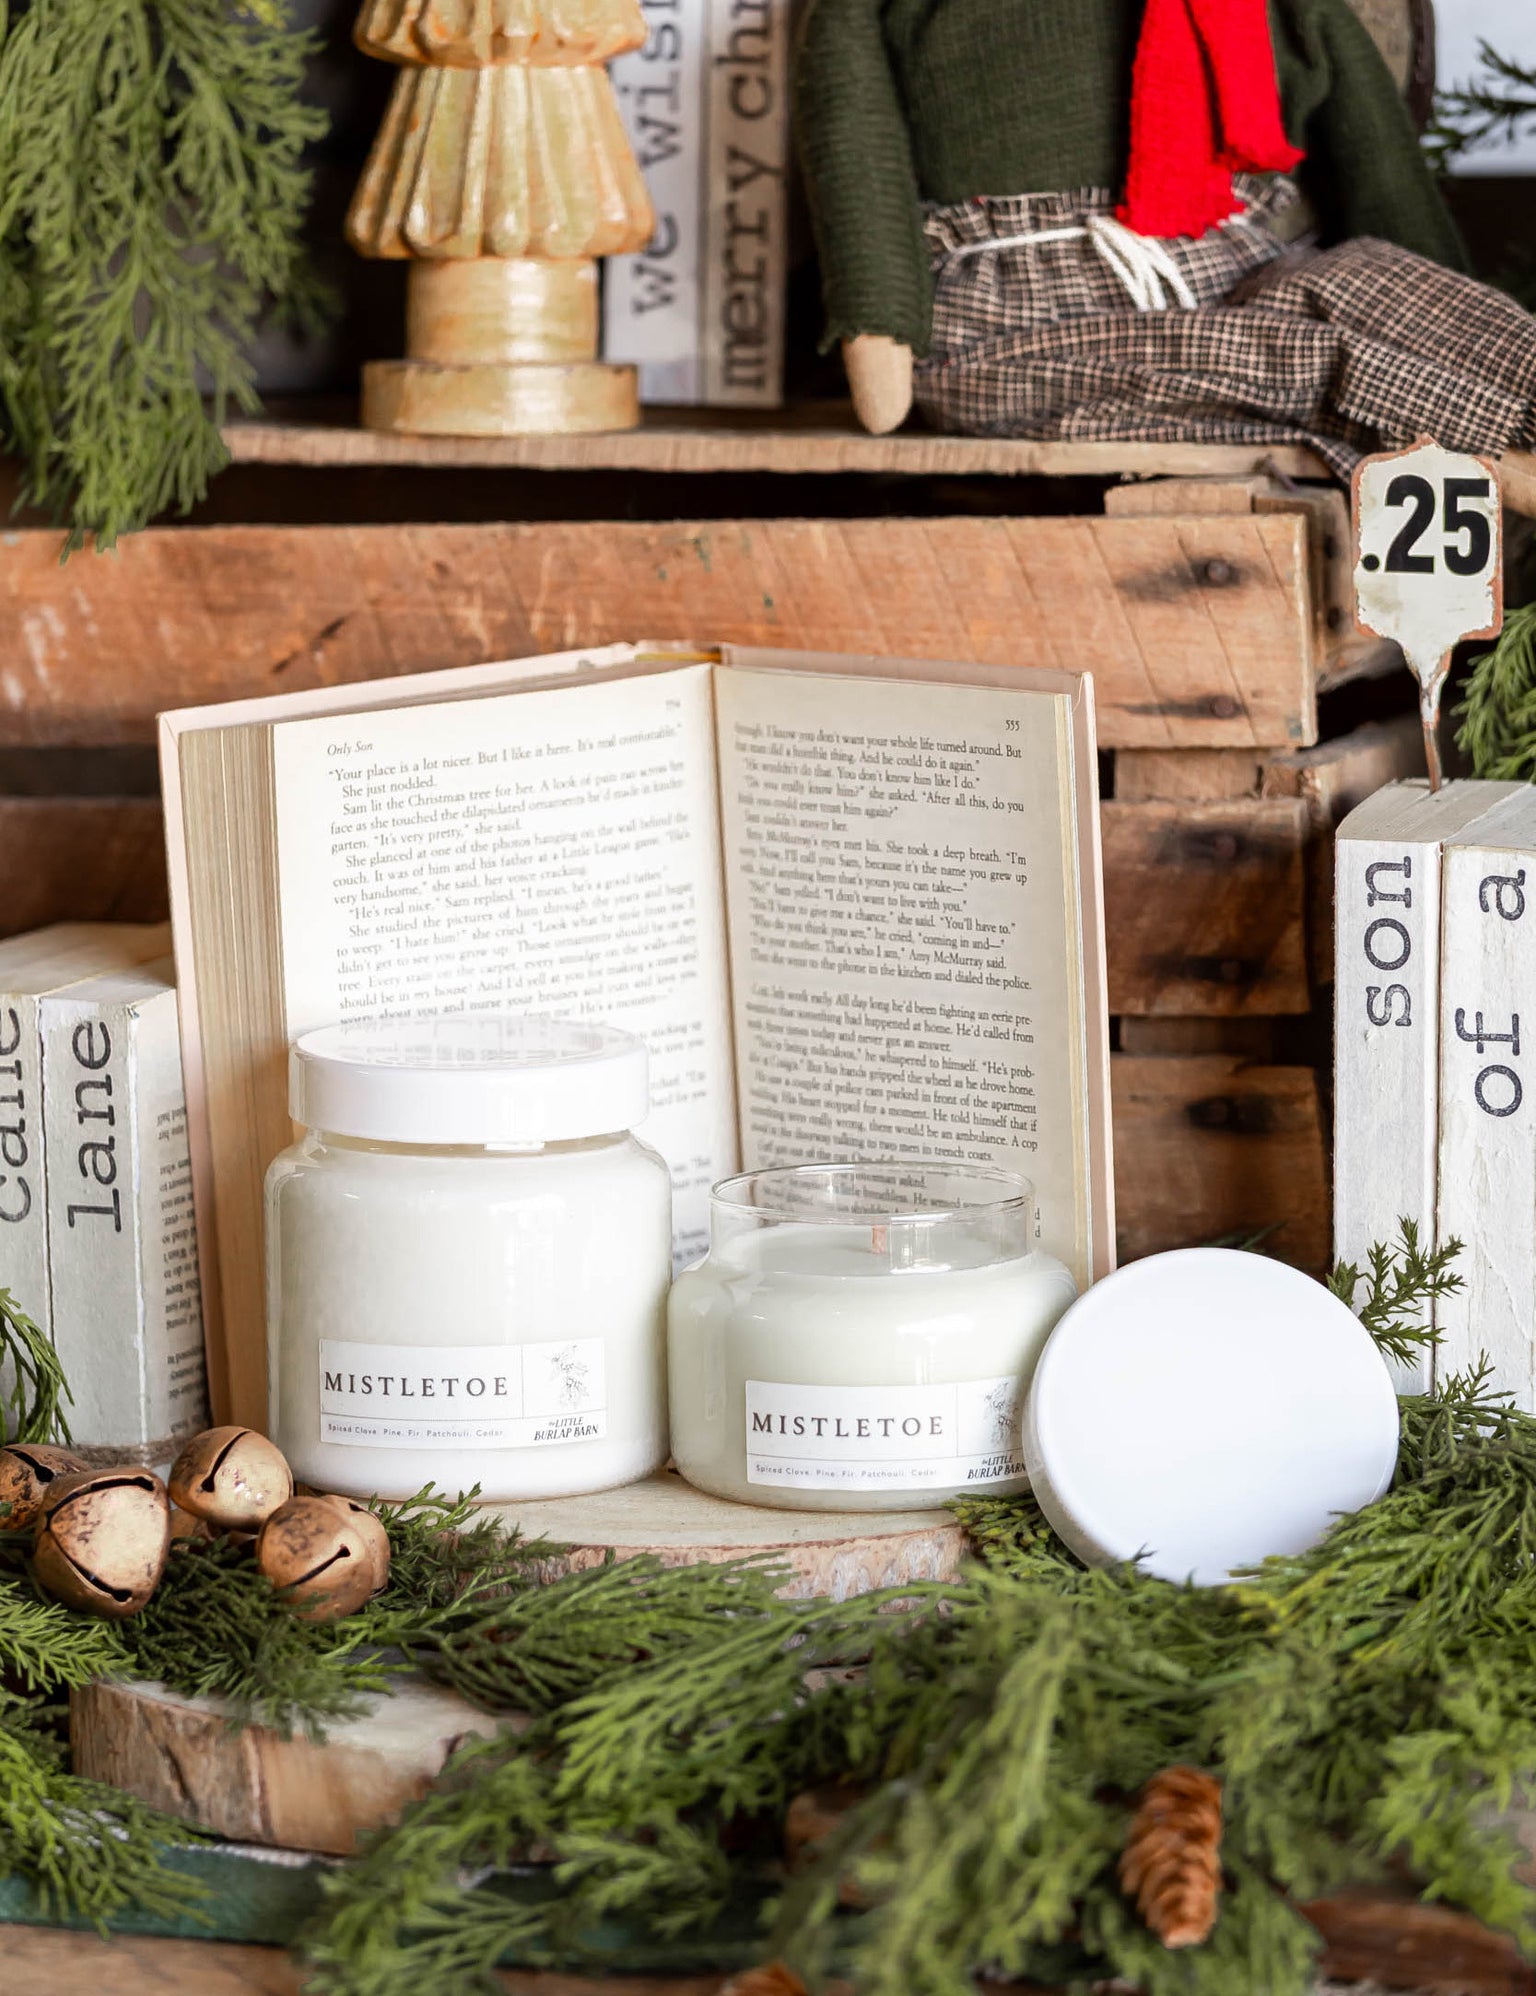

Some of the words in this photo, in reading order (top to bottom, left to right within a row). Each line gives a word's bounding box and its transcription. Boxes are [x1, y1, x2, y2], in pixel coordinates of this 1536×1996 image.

[621, 0, 682, 170] wis
[721, 145, 787, 391] merry
[1361, 474, 1490, 576] .25
[1006, 720, 1019, 731] 555
[327, 742, 351, 756] Only
[354, 741, 373, 752] Son
[920, 738, 934, 750] life
[936, 741, 967, 753] turned
[969, 744, 1003, 756] around.
[1006, 745, 1021, 758] But
[329, 769, 362, 781] "Your
[367, 765, 396, 780] place
[423, 759, 437, 770] lot
[478, 752, 497, 765] But
[897, 754, 922, 767] could
[925, 756, 937, 768] do
[949, 760, 979, 774] again."
[342, 785, 363, 798] She
[367, 784, 386, 797] just
[390, 775, 437, 792] nodded.
[934, 773, 951, 787] like
[343, 803, 367, 815] Sam
[371, 800, 382, 812] lit
[387, 798, 404, 810] the
[408, 794, 465, 807] Christmas
[469, 791, 491, 800] tree
[922, 791, 950, 804] "After
[955, 793, 966, 806] all
[969, 795, 989, 810] this,
[992, 797, 1005, 809] do
[1008, 802, 1024, 813] you
[331, 823, 352, 835] face
[370, 818, 389, 829] she
[392, 810, 438, 827] touched
[441, 809, 459, 821] the
[462, 800, 525, 820] dilapidated
[332, 841, 369, 855] garten.
[374, 833, 397, 846] "It's
[401, 834, 424, 844] very
[346, 855, 366, 868] She
[370, 848, 412, 868] glanced
[430, 848, 451, 857] one
[492, 837, 531, 853] photos
[908, 844, 929, 856] took
[943, 846, 965, 862] deep
[970, 848, 1001, 862] breath.
[1006, 852, 1026, 865] "I'm
[333, 872, 369, 888] couch.
[375, 870, 383, 882] It
[388, 871, 409, 879] was
[428, 863, 450, 875] him
[455, 858, 476, 872] and
[480, 857, 497, 869] his
[922, 862, 937, 875] the
[941, 867, 966, 877] name
[969, 870, 986, 880] you
[990, 872, 1012, 882] grew
[1016, 875, 1027, 886] up
[334, 895, 357, 905] very
[432, 880, 451, 892] she
[919, 898, 940, 910] with
[1478, 868, 1526, 921] a
[349, 906, 379, 919] "He's
[384, 902, 404, 915] real
[445, 896, 469, 908] Sam
[349, 925, 370, 937] She
[376, 918, 417, 934] studied
[423, 916, 441, 928] the
[446, 914, 493, 928] pictures
[940, 916, 972, 930] "You'll
[976, 919, 996, 933] have
[999, 923, 1015, 934] to."
[918, 932, 958, 949] "coming
[1363, 855, 1412, 1027] son
[337, 960, 371, 974] didn't
[909, 949, 930, 965] Amy
[934, 951, 983, 970] McMurray
[986, 957, 1007, 969] said.
[934, 969, 952, 982] and
[955, 970, 983, 984] dialed
[986, 973, 1001, 986] the
[1003, 976, 1032, 990] police.
[340, 993, 377, 1009] should
[939, 1004, 975, 1022] fighting
[991, 1013, 1013, 1023] eerie
[1016, 1016, 1032, 1027] pre-
[924, 1020, 953, 1034] home.
[957, 1023, 980, 1037] He'd
[983, 1027, 1010, 1040] called
[1013, 1029, 1034, 1043] from
[917, 1041, 951, 1052] answer.
[942, 1056, 978, 1072] himself.
[982, 1061, 1008, 1075] "He's
[1011, 1066, 1035, 1079] prob-
[1455, 1007, 1523, 1118] of
[924, 1073, 951, 1087] wheel
[980, 1078, 1006, 1093] drove
[1009, 1081, 1035, 1096] home.
[934, 1090, 957, 1105] front
[973, 1095, 988, 1108] the
[991, 1101, 1036, 1114] apartment
[68, 1018, 123, 1232] lane
[933, 1108, 948, 1122] He
[951, 1111, 970, 1124] told
[973, 1113, 1007, 1128] himself
[1010, 1117, 1027, 1131] that
[1031, 1120, 1037, 1132] if
[955, 1129, 1008, 1145] ambulance.
[1021, 1140, 1038, 1152] cop
[934, 1146, 965, 1158] trench
[968, 1151, 994, 1161] coats.
[324, 1371, 508, 1397] MISTLETOE
[328, 1423, 352, 1433] Spiced
[476, 1429, 503, 1437] Cedar
[534, 1427, 572, 1441] BURLAP
[574, 1424, 598, 1437] BARN
[555, 1416, 584, 1428] LITTLE
[752, 1412, 943, 1437] MISTLETOE
[756, 1464, 782, 1474] Spiced
[967, 1465, 1003, 1479] BURLAP
[1004, 1462, 1026, 1475] BARN
[988, 1455, 1014, 1466] LITTLE
